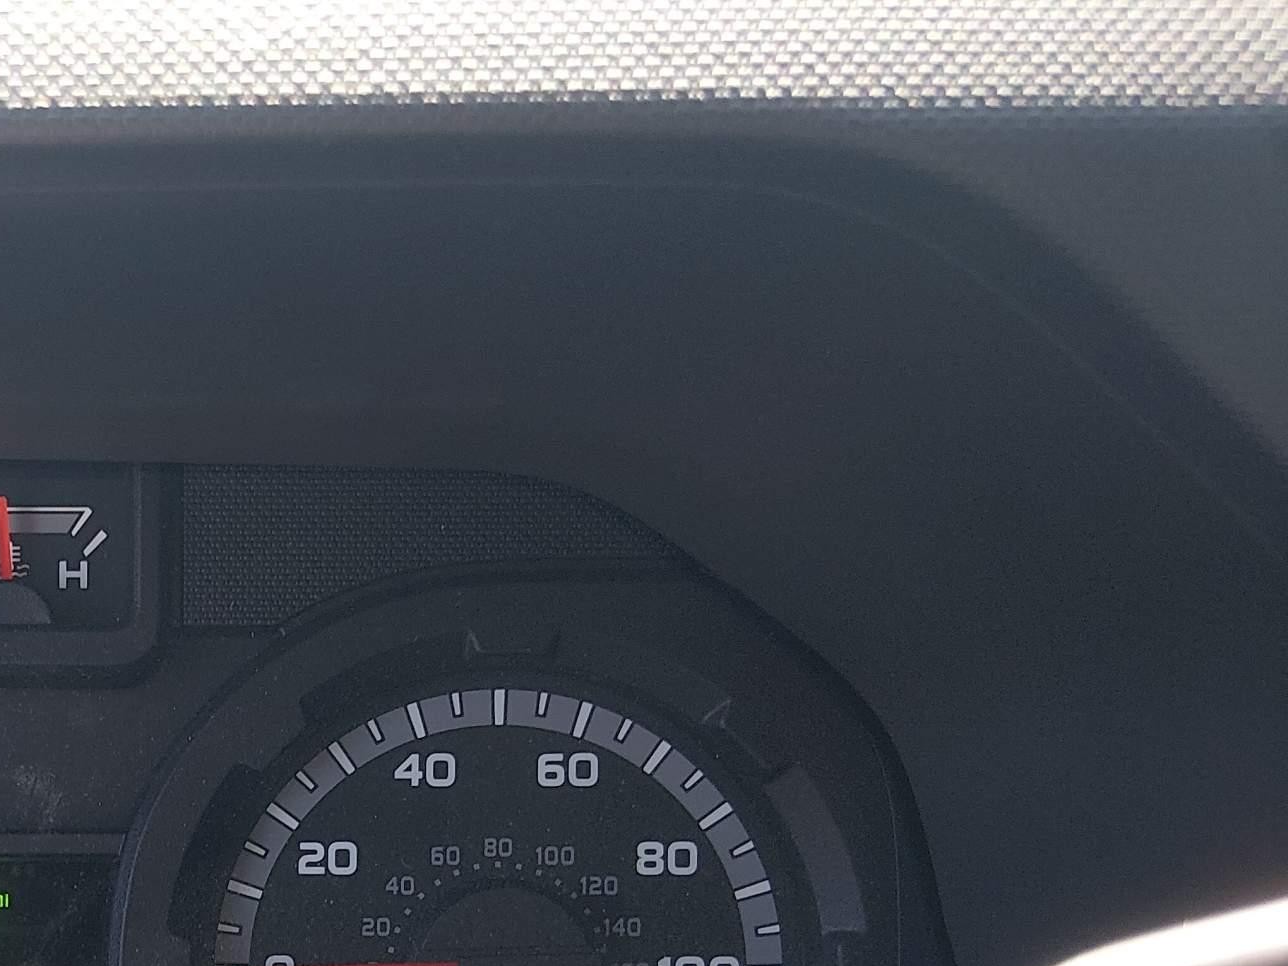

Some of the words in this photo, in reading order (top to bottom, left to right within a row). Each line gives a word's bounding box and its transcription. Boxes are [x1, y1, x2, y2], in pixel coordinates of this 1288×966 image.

[59, 560, 88, 589] H
[394, 753, 456, 787] 40
[537, 753, 599, 787] 60
[298, 841, 358, 875] 20
[430, 846, 461, 866] 60
[483, 838, 512, 858] 80
[535, 846, 575, 866] 100
[636, 841, 698, 876] 80
[385, 876, 414, 896] 40
[579, 876, 618, 896] 120
[361, 917, 391, 937] 20
[603, 917, 641, 937] 140
